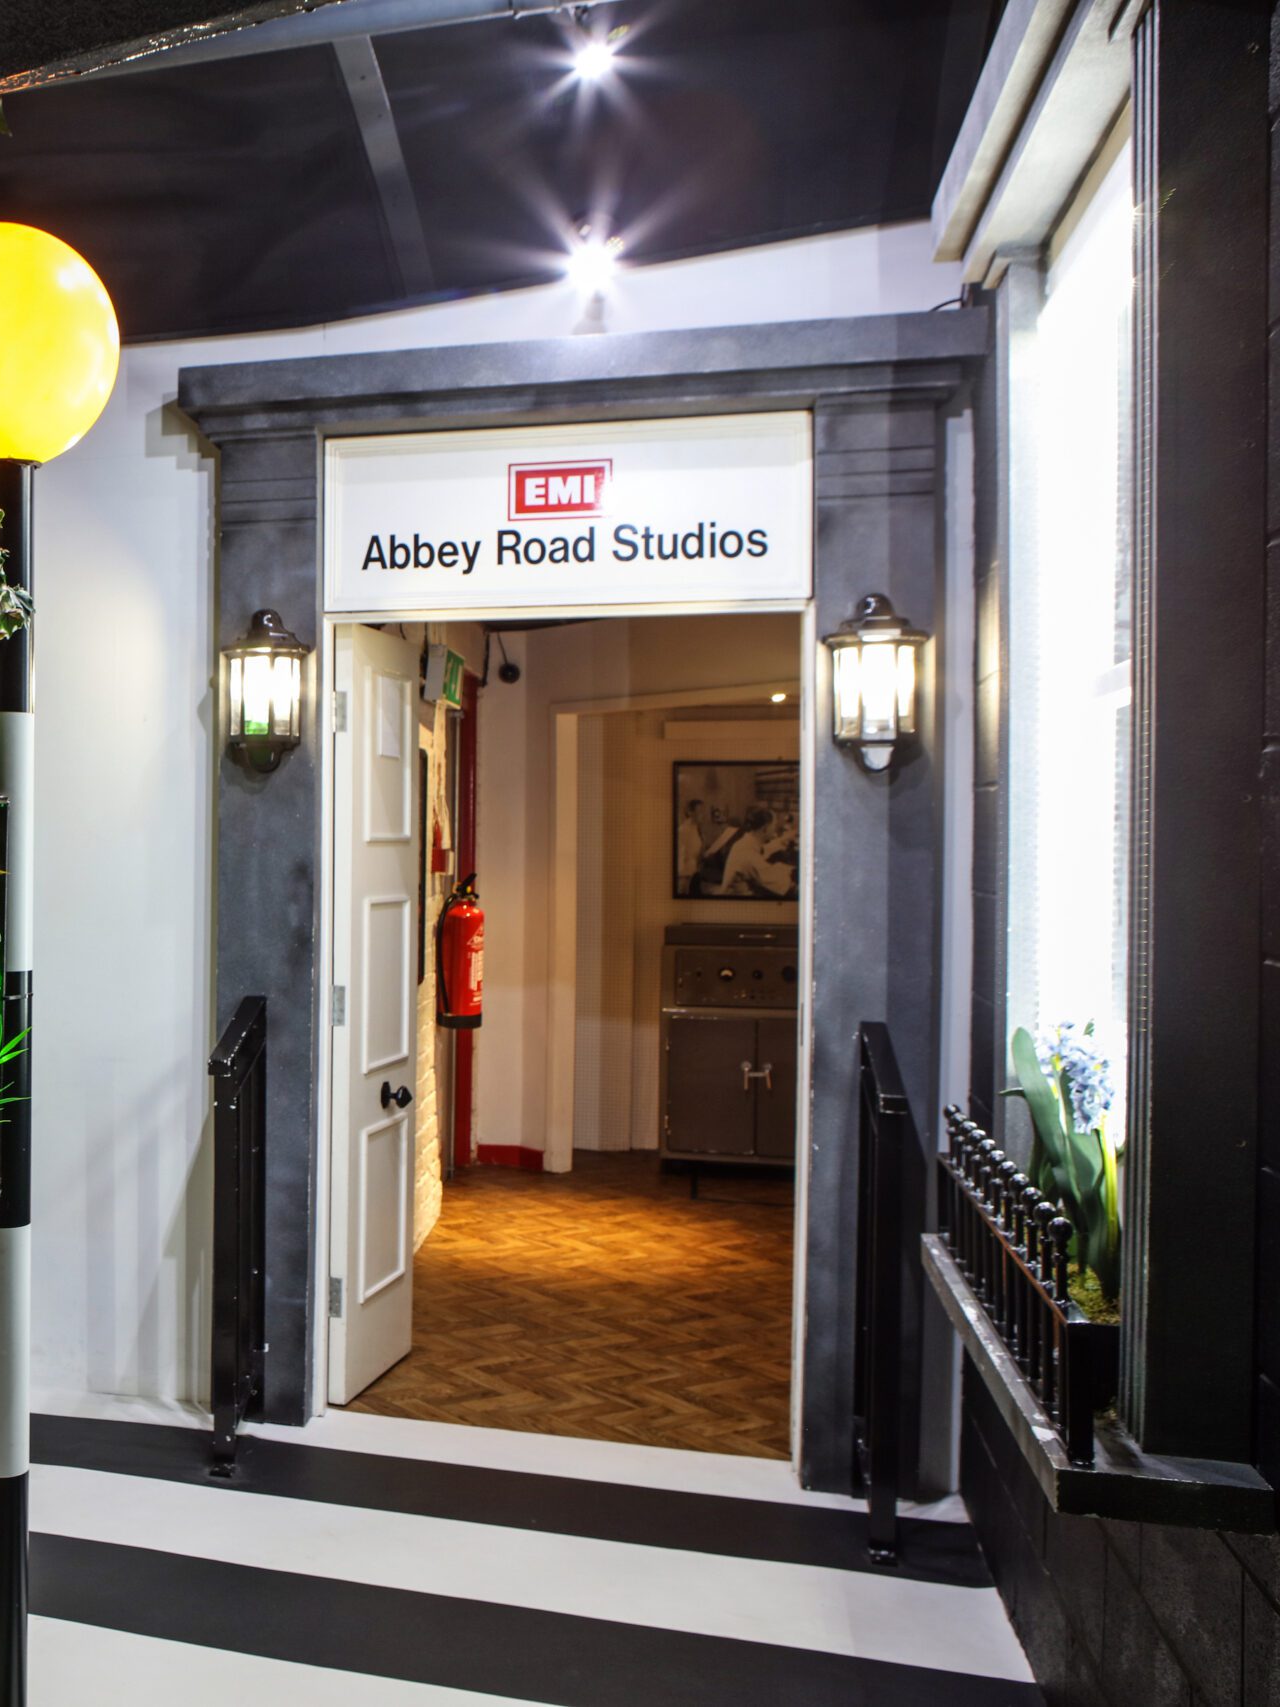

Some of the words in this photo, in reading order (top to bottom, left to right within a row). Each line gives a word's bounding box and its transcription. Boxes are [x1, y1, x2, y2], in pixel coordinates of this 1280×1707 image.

[523, 474, 596, 507] EMI
[361, 533, 481, 575] Abbey
[496, 526, 596, 565] Road
[612, 522, 769, 562] Studios
